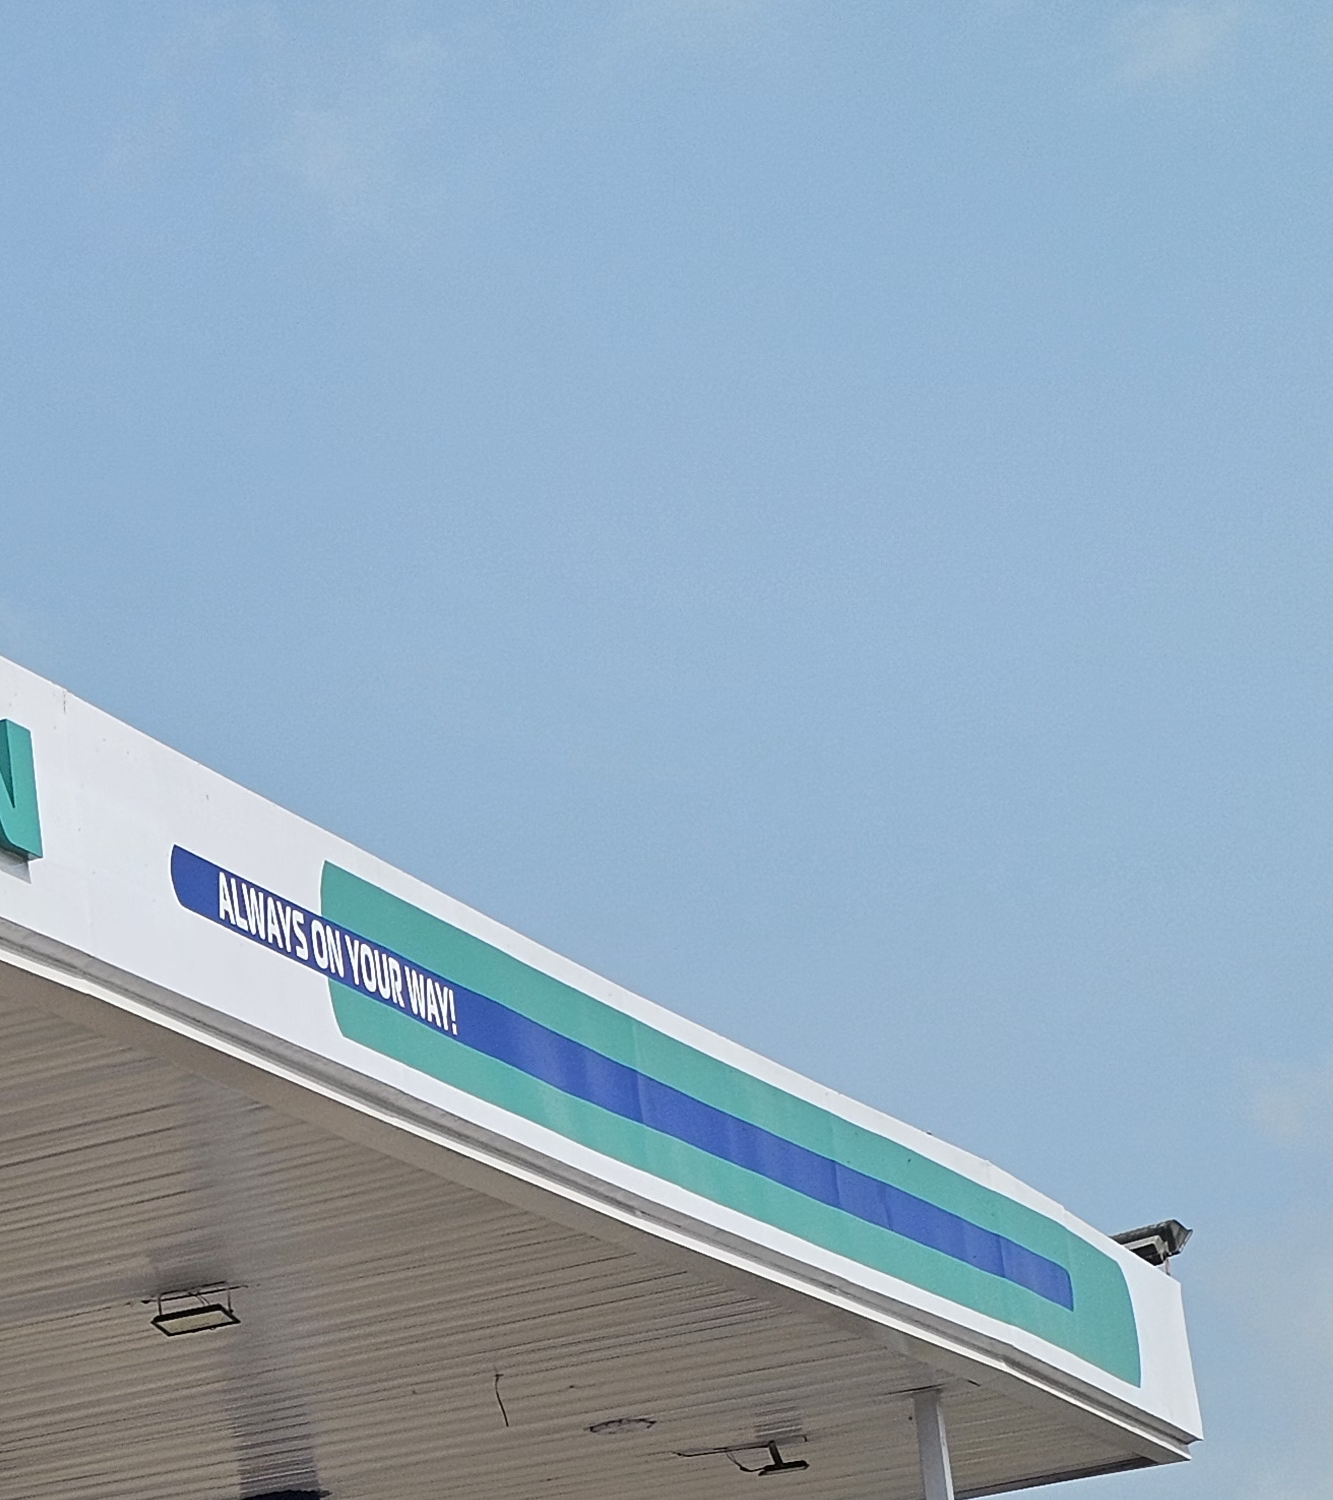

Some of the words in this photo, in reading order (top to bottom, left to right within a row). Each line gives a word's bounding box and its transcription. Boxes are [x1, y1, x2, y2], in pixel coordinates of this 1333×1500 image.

[219, 871, 309, 960] ALWAYS
[311, 919, 346, 979] ON
[344, 934, 406, 1009] YOUR
[404, 965, 458, 1036] WAY!
